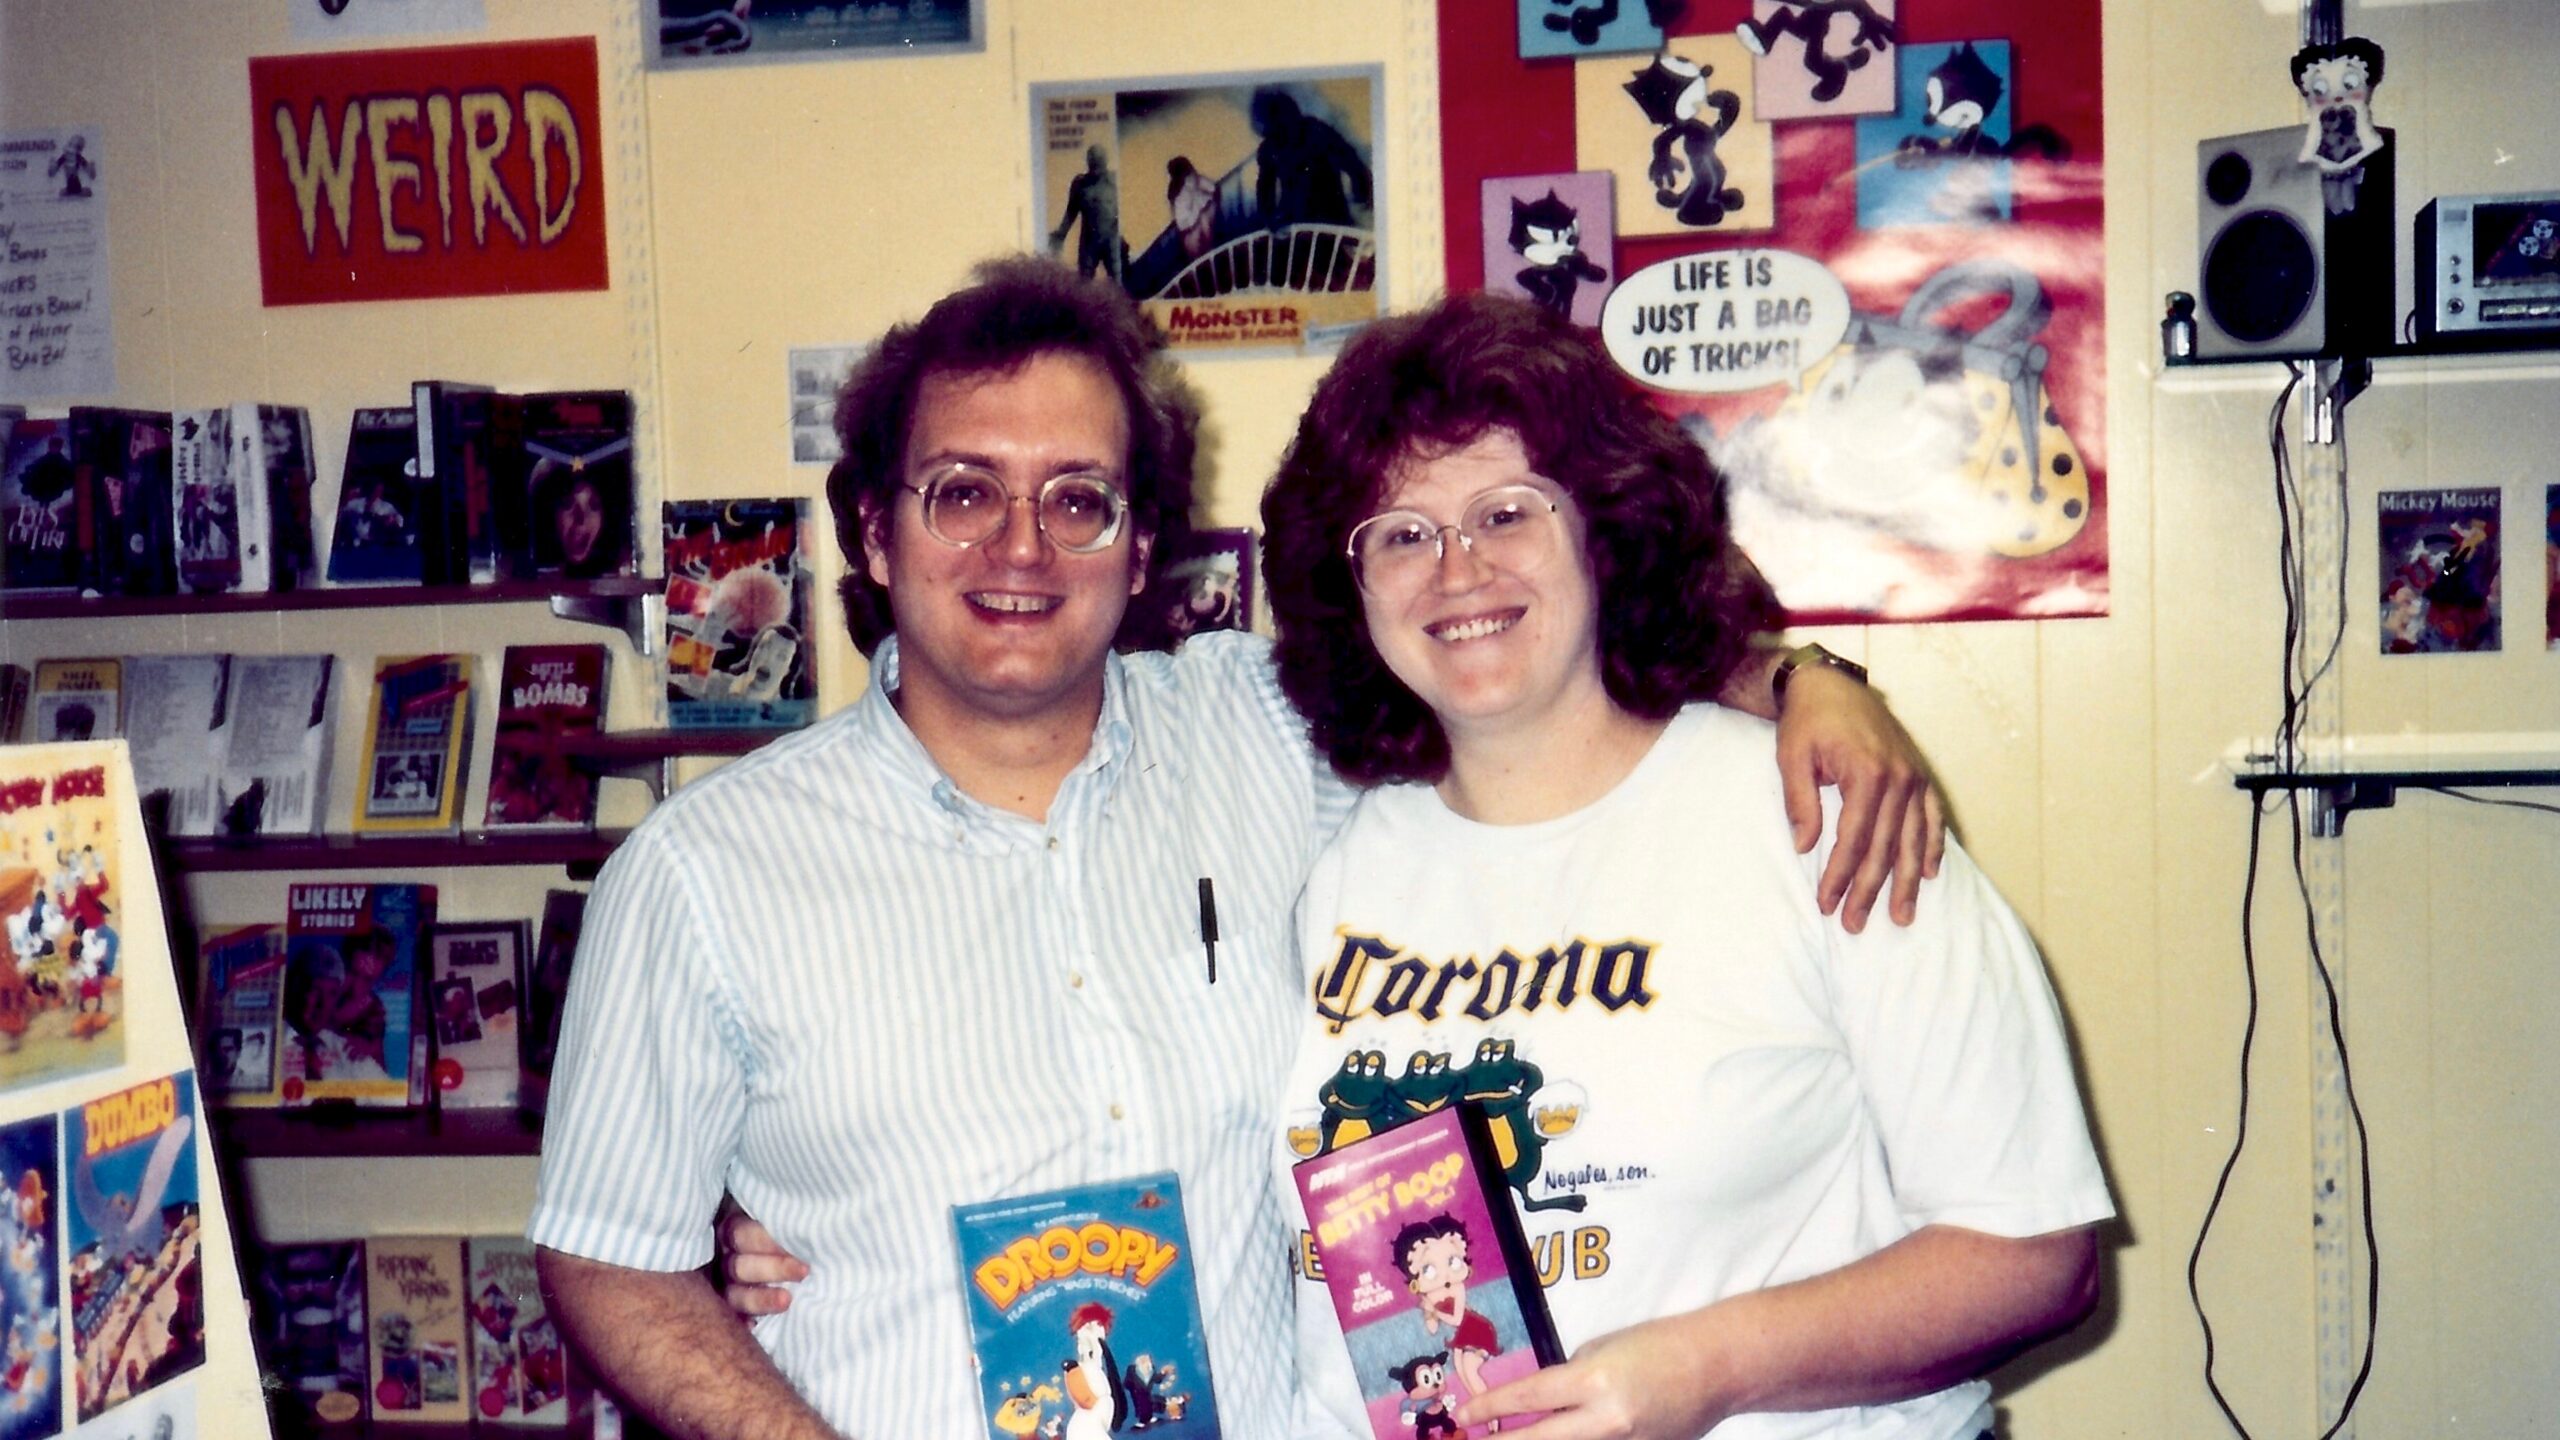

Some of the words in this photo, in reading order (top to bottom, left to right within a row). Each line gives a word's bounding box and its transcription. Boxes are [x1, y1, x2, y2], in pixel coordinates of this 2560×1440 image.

[275, 90, 582, 255] WEIRD
[1674, 260, 1730, 291] LIFE
[1746, 257, 1772, 286] IS
[1169, 305, 1298, 330] MONSTER
[1633, 302, 1700, 335] JUST
[1718, 300, 1736, 330] A
[1756, 297, 1812, 329] BAG
[1643, 345, 1677, 376] OF
[1690, 338, 1801, 373] TRICKS!
[2380, 494, 2437, 512] Mickey
[2441, 491, 2497, 509] Mouse
[513, 682, 590, 709] BOMBS
[292, 888, 366, 911] LIKELY
[301, 914, 355, 928] STORIES
[1315, 924, 1661, 1037] Corona
[83, 1077, 175, 1157] DUMBO
[1317, 1190, 1390, 1247] BETTY
[1393, 1152, 1465, 1208] BOOP
[974, 1221, 1178, 1311] DROOPY
